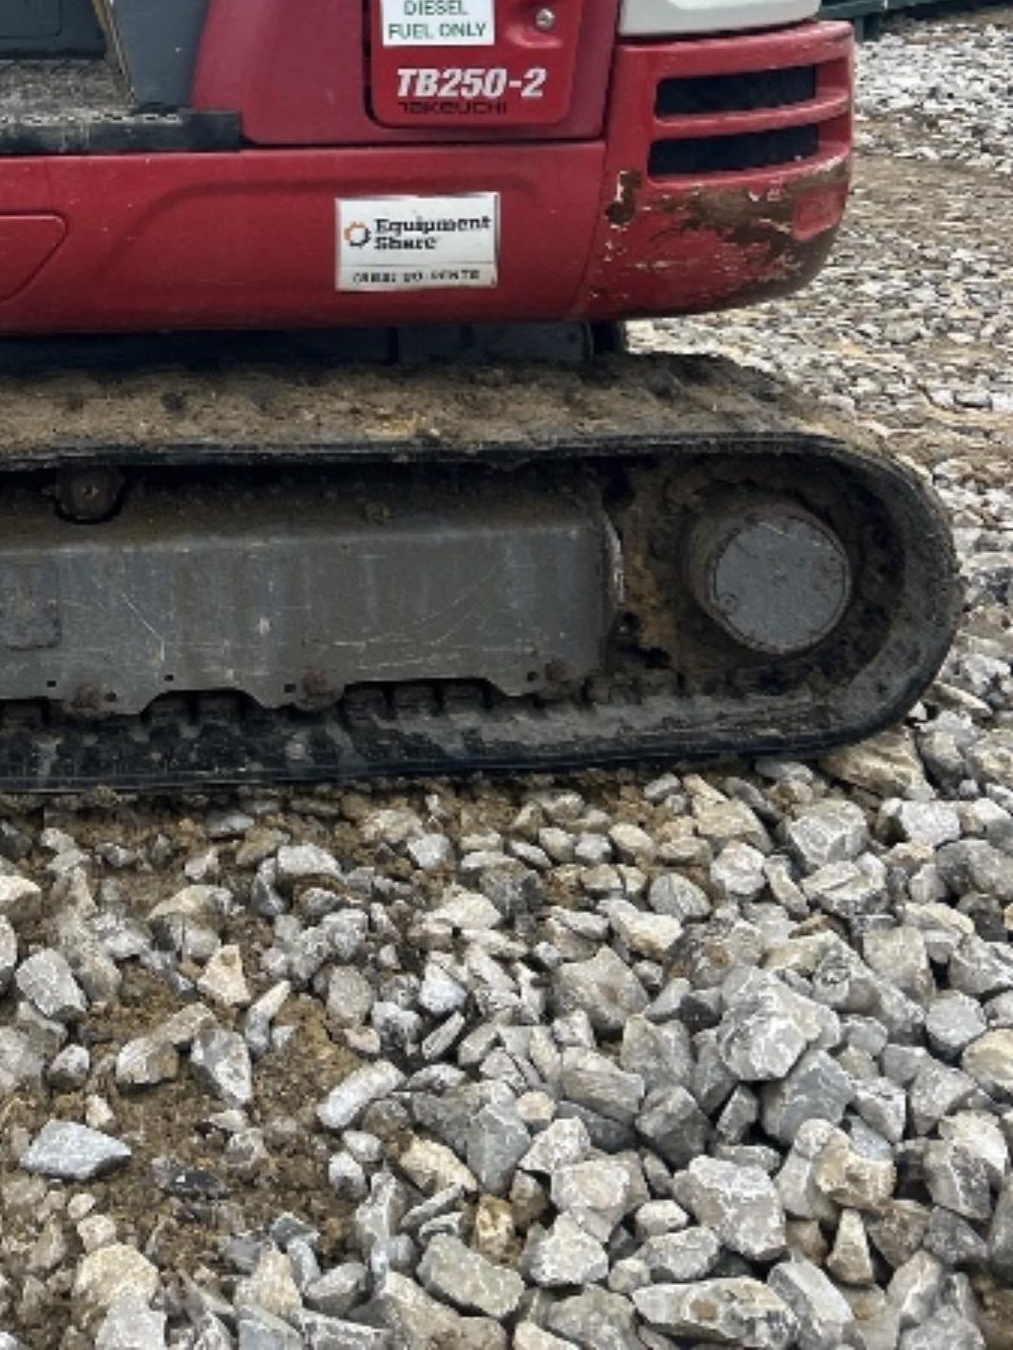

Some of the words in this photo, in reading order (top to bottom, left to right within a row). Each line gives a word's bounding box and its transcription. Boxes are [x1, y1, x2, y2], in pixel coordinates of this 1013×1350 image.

[403, 0, 468, 15] DIESEL
[388, 23, 434, 39] FUEL
[439, 21, 487, 37] ONLY
[396, 67, 547, 98] TB250-2
[374, 215, 492, 237] Equipment
[374, 236, 437, 250] Share
